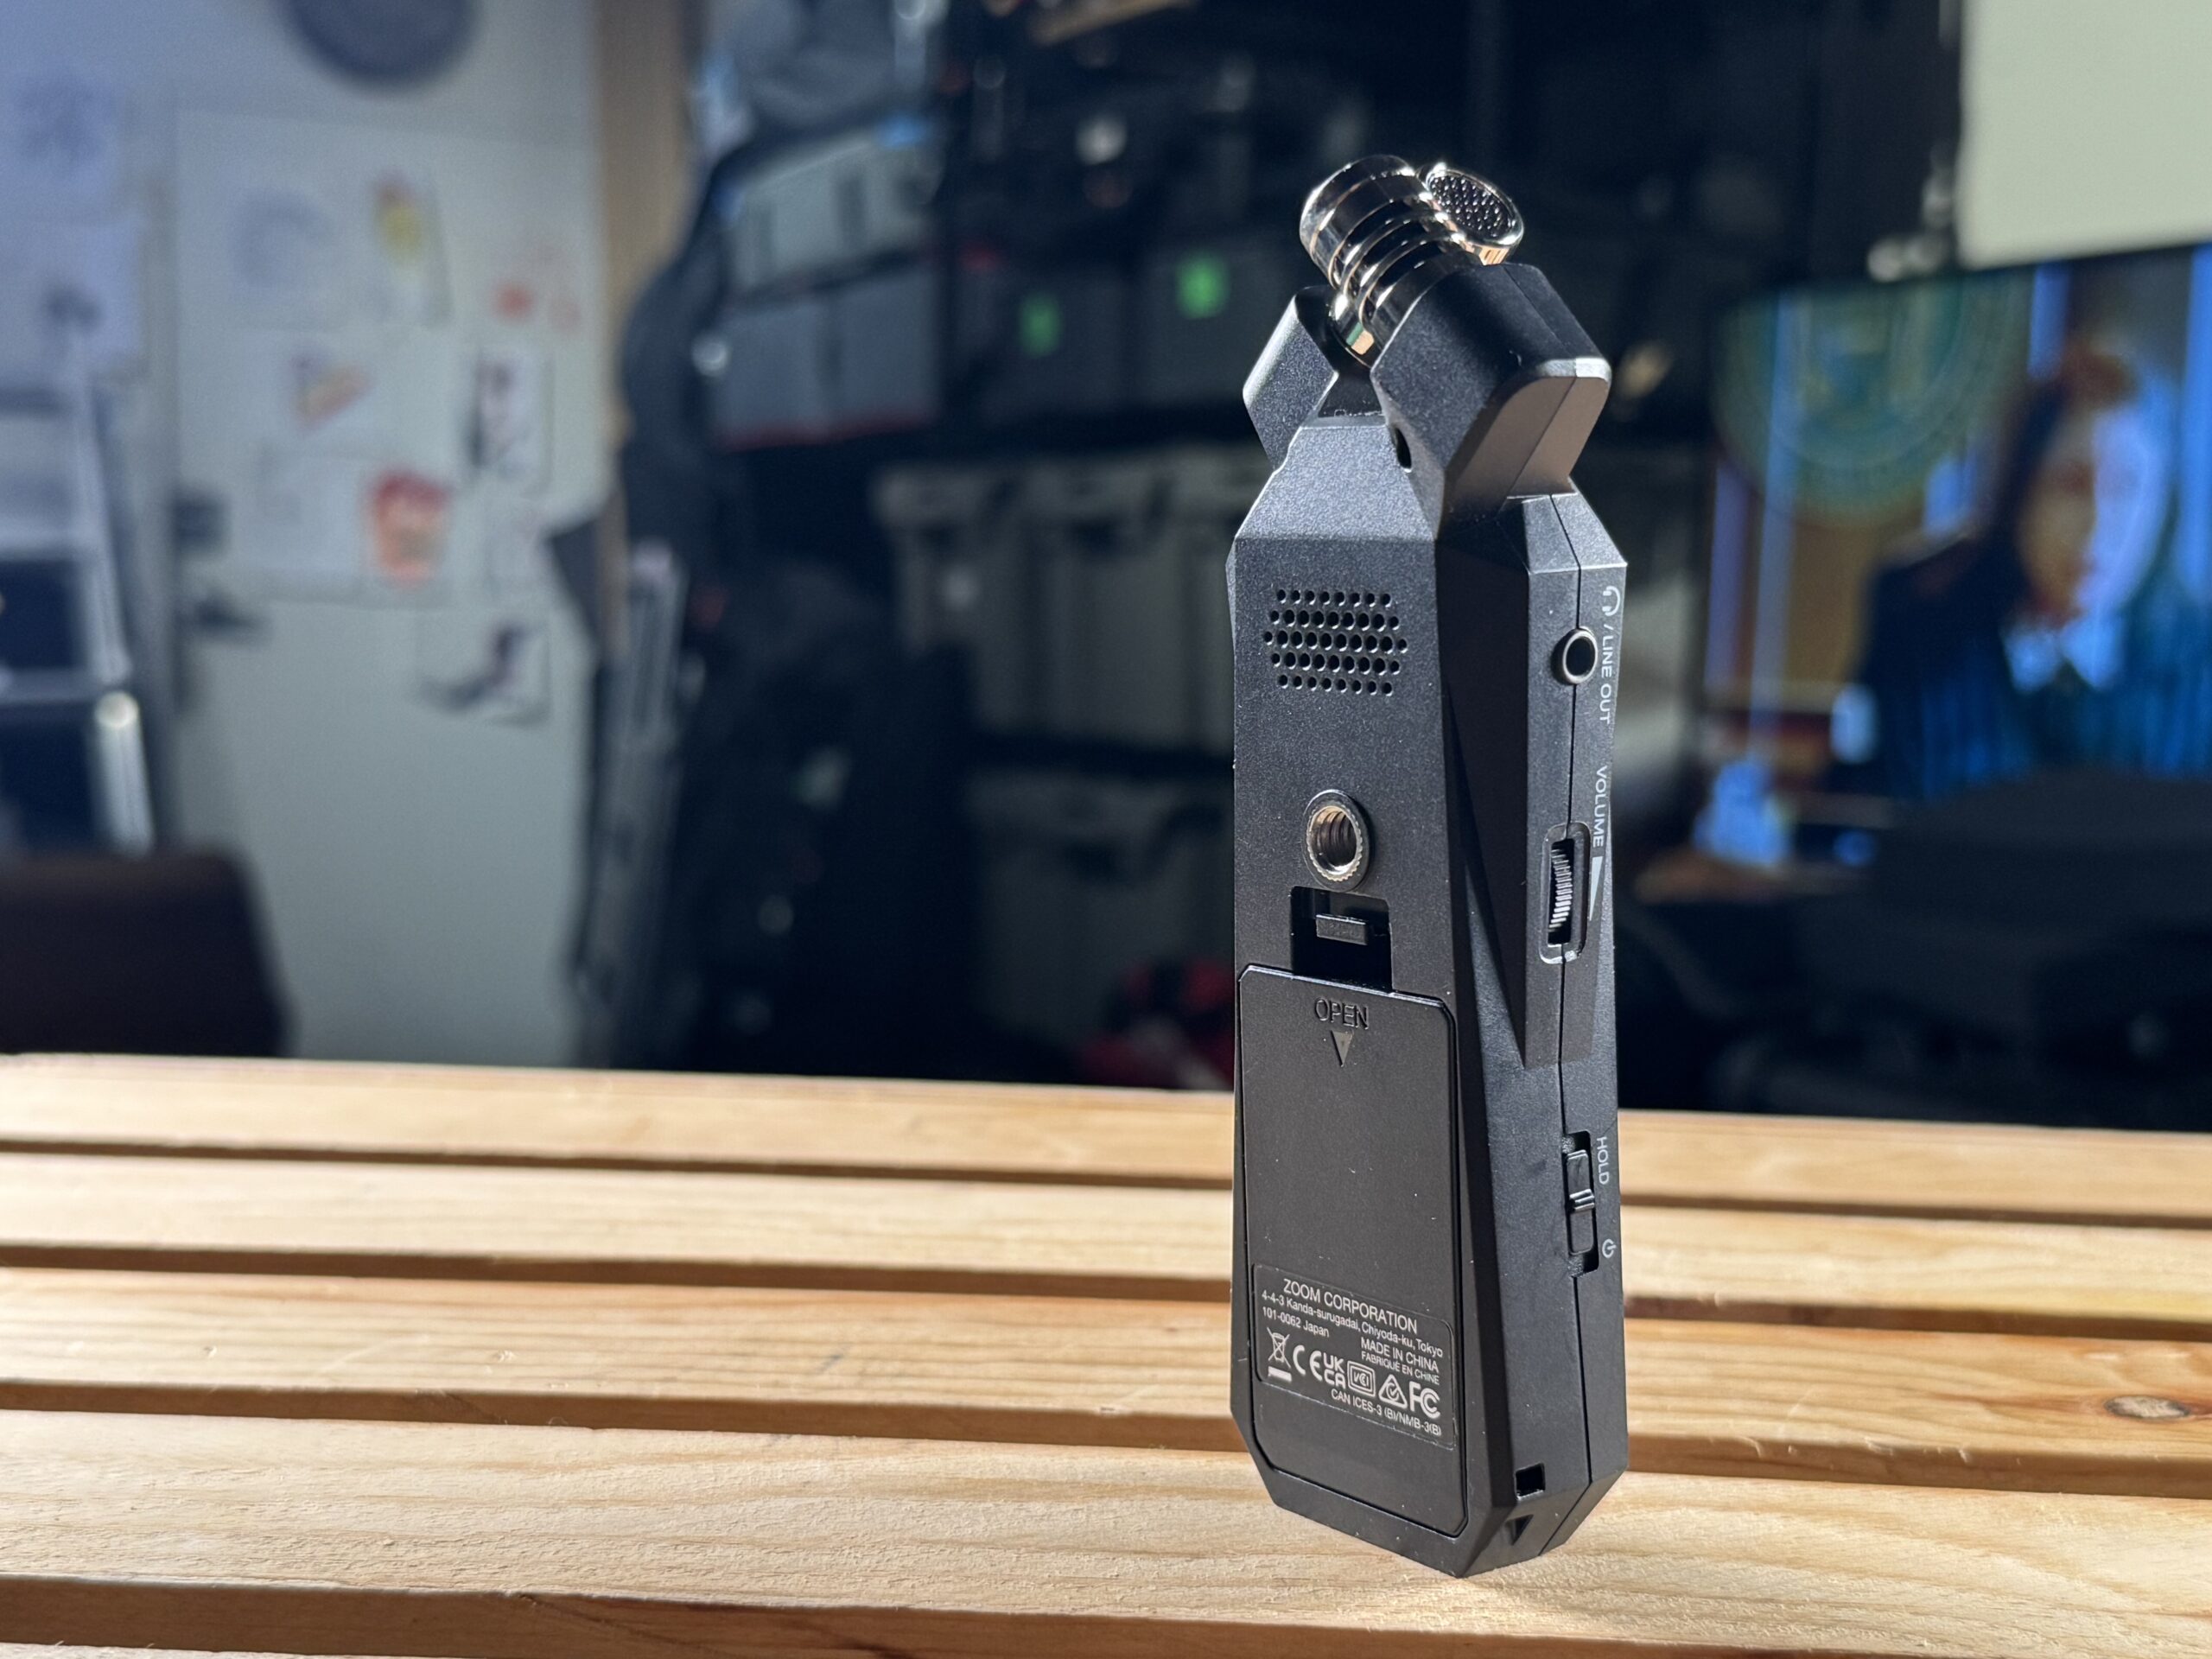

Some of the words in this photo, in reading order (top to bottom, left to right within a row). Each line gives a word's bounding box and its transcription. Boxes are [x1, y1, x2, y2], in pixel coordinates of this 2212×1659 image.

[1600, 634, 1614, 678] LINE
[1599, 683, 1612, 724] OUT
[1592, 766, 1608, 848] VOLUME
[1314, 996, 1370, 1030] OPEN
[1596, 1136, 1610, 1185] HOLD
[1262, 1307, 1300, 1326] 101-0062
[1304, 1320, 1329, 1338] Japan
[1262, 1290, 1285, 1306] 4-4-3
[1287, 1294, 1360, 1332] Kanda-surugadai,
[1362, 1321, 1415, 1350] Chiyoda-ku,
[1417, 1340, 1443, 1357] Tokyo
[1283, 1279, 1320, 1301] ZOOM
[1325, 1292, 1417, 1333] CORPORATION
[1362, 1337, 1389, 1357] MADE
[1393, 1345, 1402, 1359] IN
[1406, 1351, 1439, 1373] CHINA
[1362, 1351, 1400, 1371] FABRIQUÉ
[1402, 1364, 1413, 1376] EN
[1415, 1369, 1440, 1384] CHINE
[1332, 1389, 1351, 1405] CAN
[1353, 1396, 1382, 1415] ICES-3
